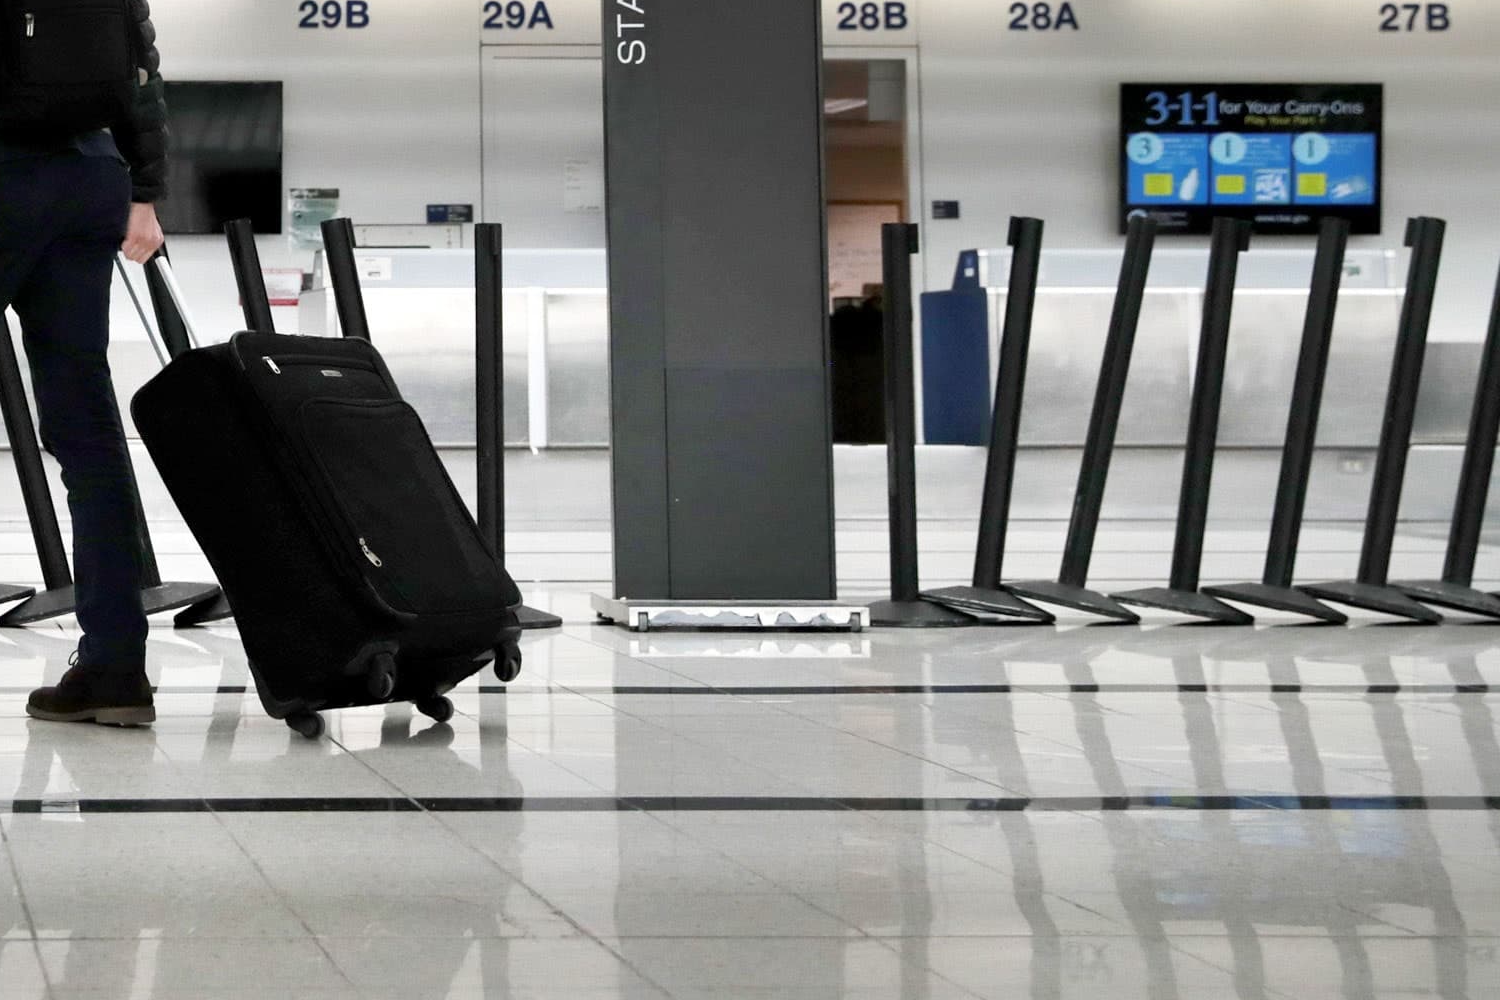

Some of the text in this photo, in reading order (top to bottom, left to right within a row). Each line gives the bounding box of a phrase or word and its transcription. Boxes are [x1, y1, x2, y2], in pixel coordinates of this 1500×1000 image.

[298, 0, 370, 28] 29B
[482, 0, 553, 29] 29A
[837, 1, 907, 30] 28B
[1007, 2, 1079, 31] 28A
[1379, 3, 1450, 32] 27B
[1144, 91, 1221, 125] 3-1-1
[1219, 100, 1242, 114] for
[1245, 100, 1282, 114] Your
